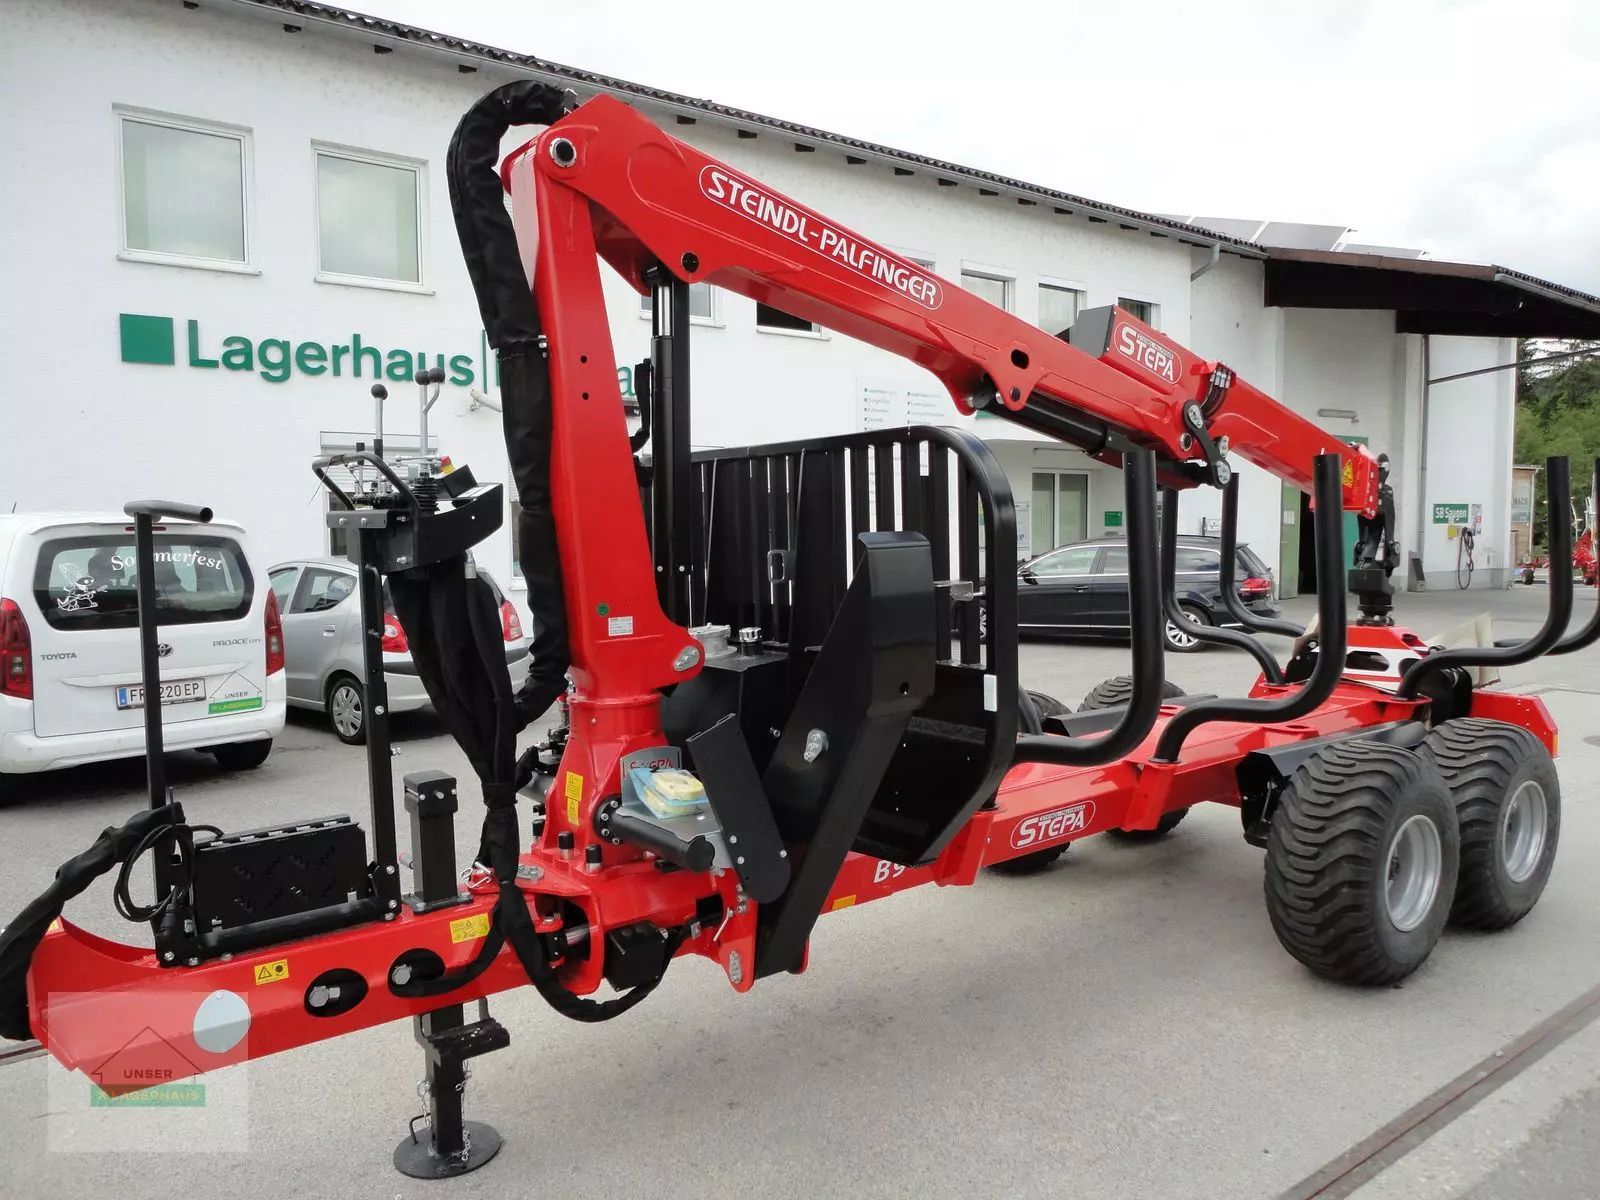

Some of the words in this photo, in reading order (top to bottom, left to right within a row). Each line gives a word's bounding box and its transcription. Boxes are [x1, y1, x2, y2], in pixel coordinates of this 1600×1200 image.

[708, 171, 937, 305] STEINDL-PALFINGER
[188, 319, 474, 387] Lagerhaus
[1119, 326, 1174, 382] STEPA
[1435, 507, 1444, 519] SB
[110, 549, 224, 571] Somerfest
[212, 638, 248, 647] PROACE
[40, 652, 77, 661] TOYOTA
[184, 682, 200, 696] EP
[224, 691, 248, 699] UNSER
[1016, 810, 1085, 847] STEPA
